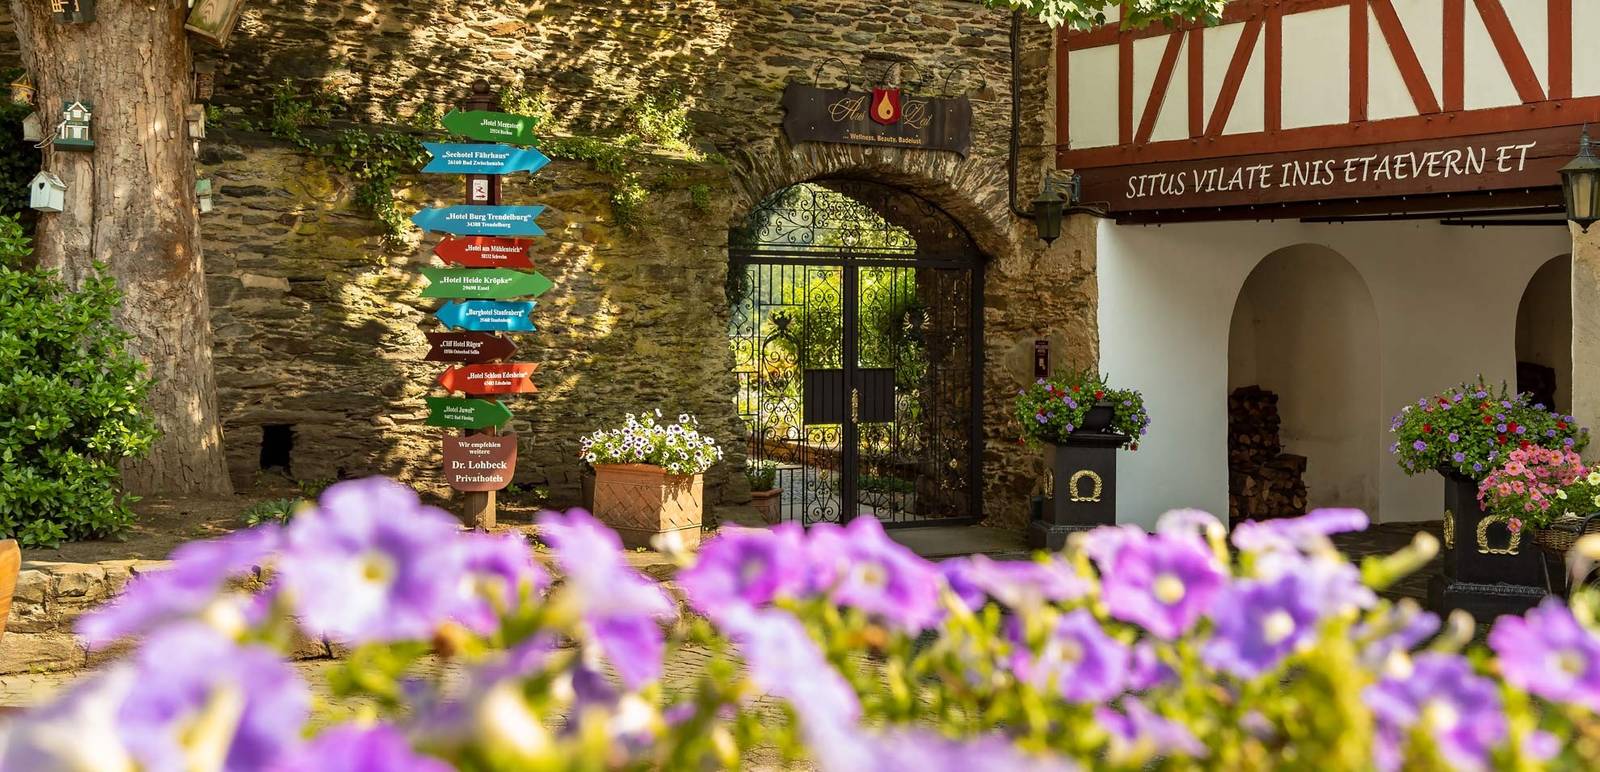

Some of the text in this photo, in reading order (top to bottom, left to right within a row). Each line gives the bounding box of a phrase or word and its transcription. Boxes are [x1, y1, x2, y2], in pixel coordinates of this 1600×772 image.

[1126, 141, 1536, 199] SITUS VILATE INIS ETAEVERN ET
[469, 461, 507, 469] Lohbeck
